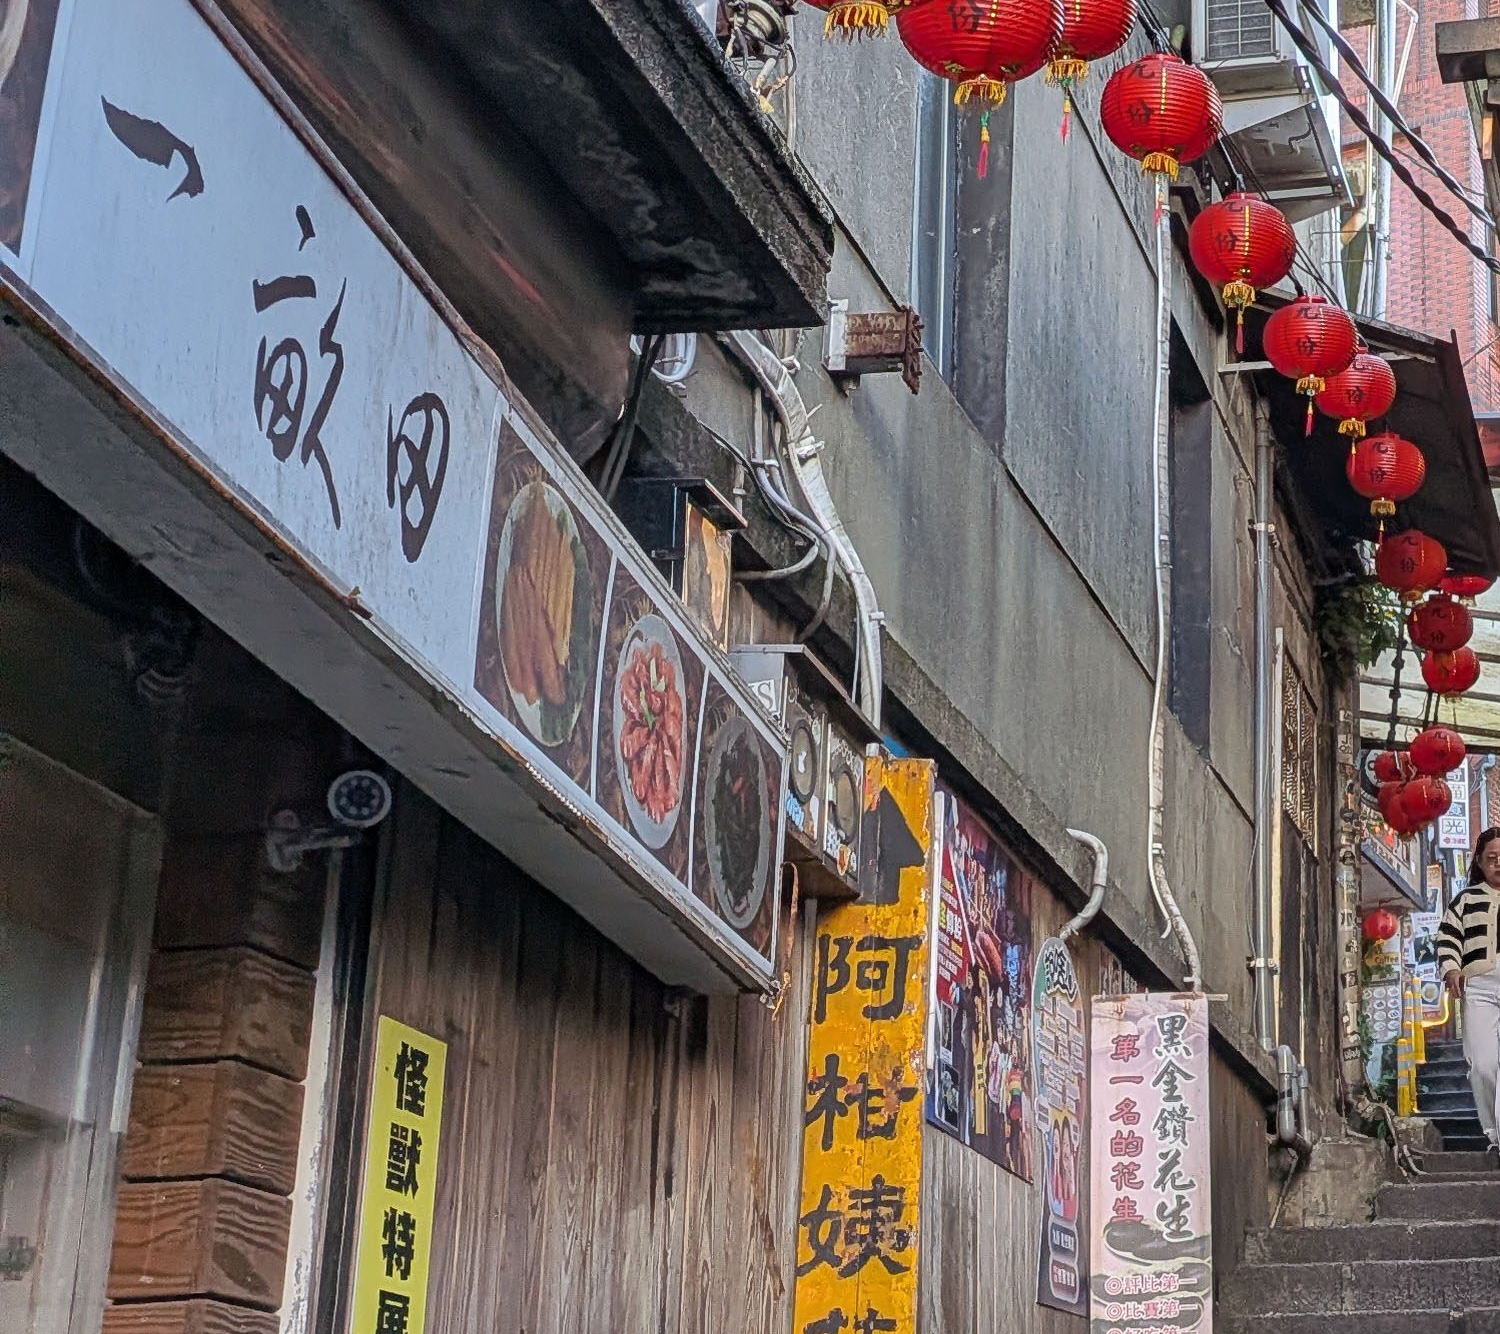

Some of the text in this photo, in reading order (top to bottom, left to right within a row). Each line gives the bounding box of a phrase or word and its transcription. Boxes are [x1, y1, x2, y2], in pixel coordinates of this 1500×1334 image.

[1109, 1033, 1144, 1224] 第一名的花生
[1152, 1013, 1197, 1242] 黑金鑽花生
[1124, 1275, 1198, 1294] 評比第一
[1124, 1301, 1198, 1319] 比賽第一
